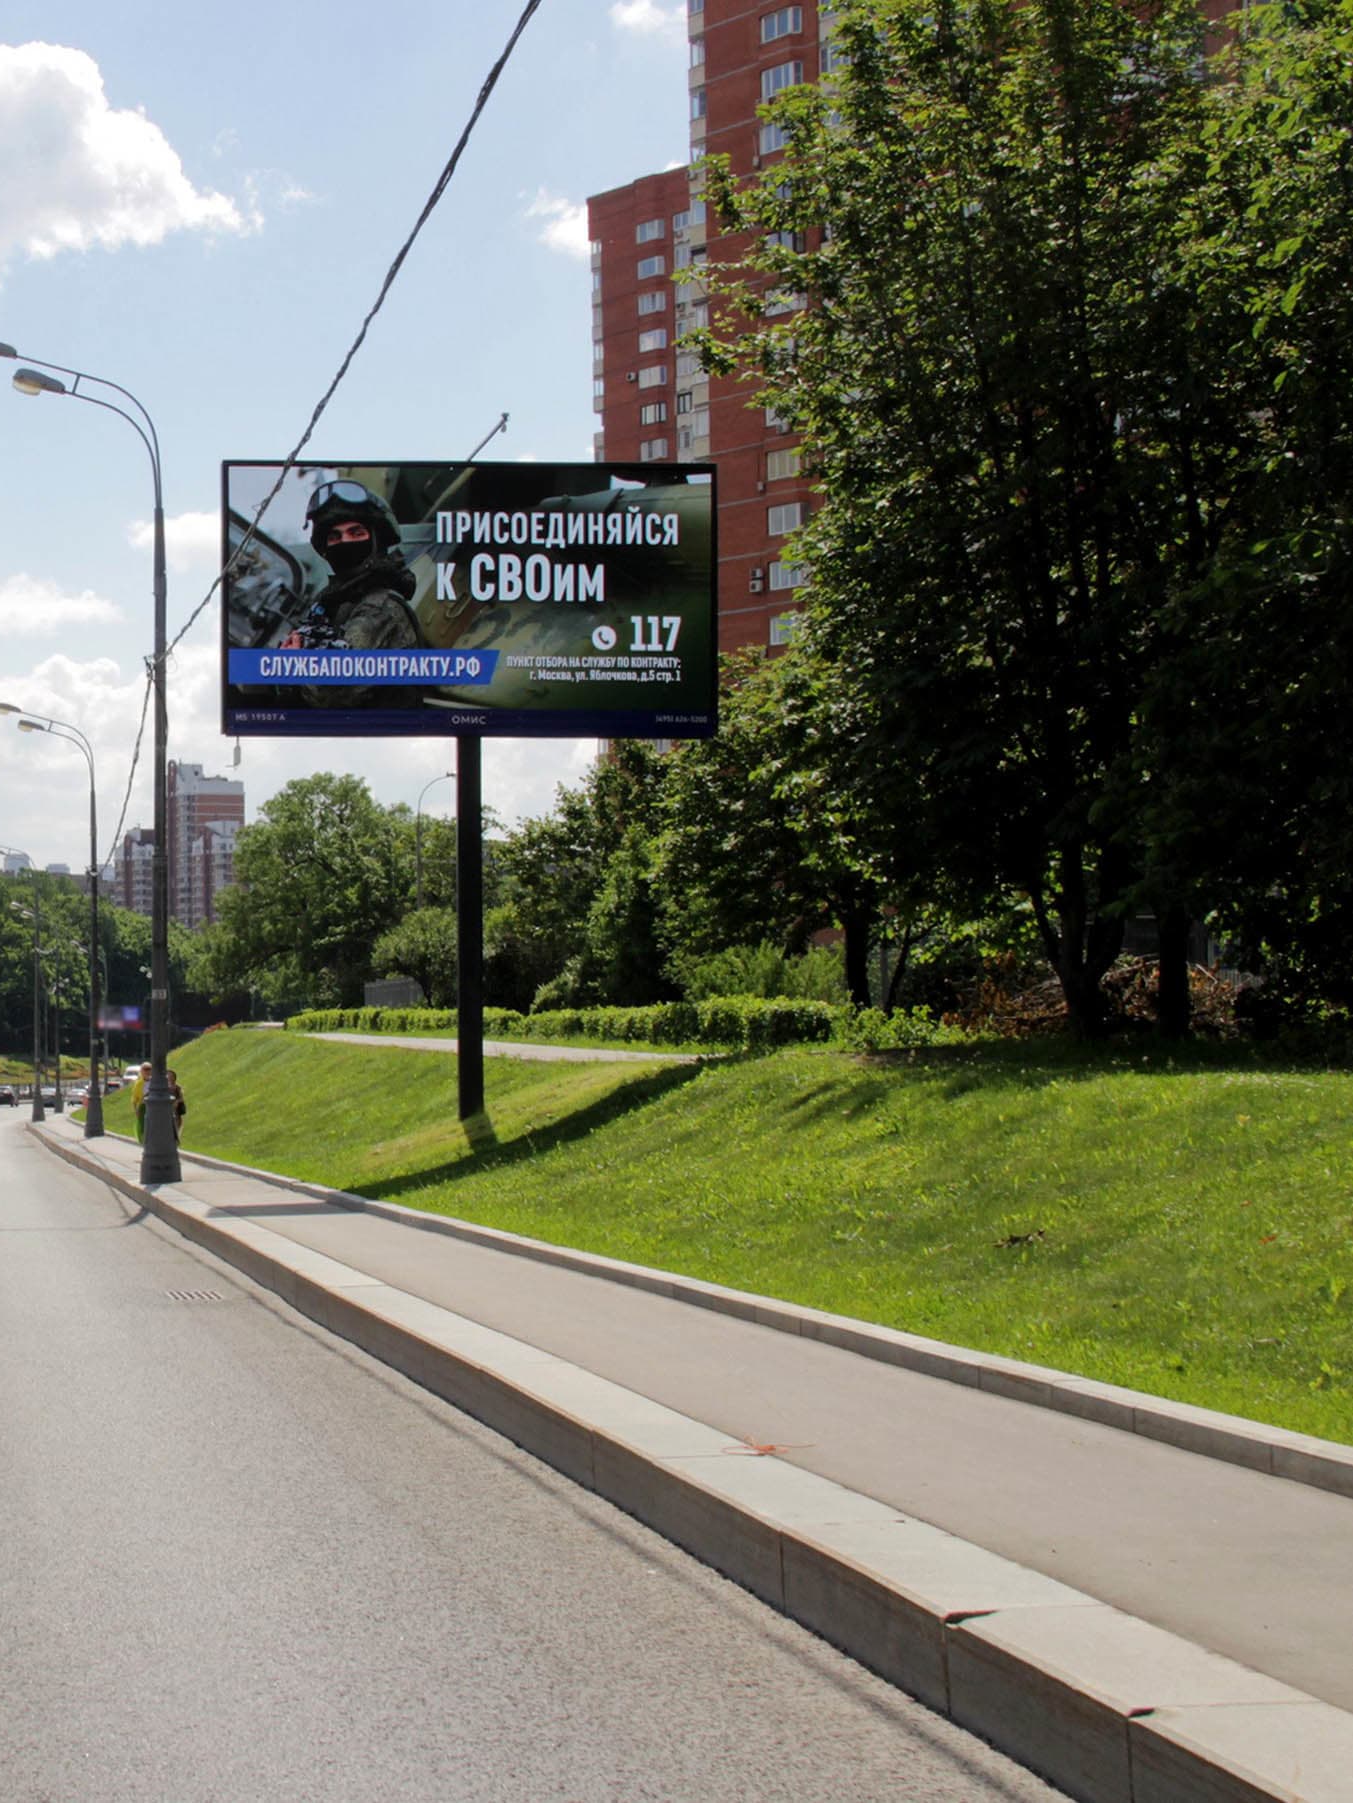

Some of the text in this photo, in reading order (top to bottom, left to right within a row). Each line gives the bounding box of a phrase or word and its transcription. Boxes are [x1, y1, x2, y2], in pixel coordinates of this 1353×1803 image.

[436, 506, 679, 549] ПРИСОЕДИНЯЙСЯ
[630, 616, 681, 651] 117
[260, 656, 481, 677] СЛУЖБАПОКОНТРАКТУ.РФ
[506, 655, 681, 669] ПУНКТ ОТБОРА НА СЛУЖБУ ПО КОНТРАКТУ:
[538, 669, 574, 682] Москва,
[575, 671, 589, 683] ул.
[589, 669, 639, 683] Яблочкова,
[655, 672, 675, 684] стр.
[675, 670, 681, 682] 1
[451, 714, 487, 725] ОМИС
